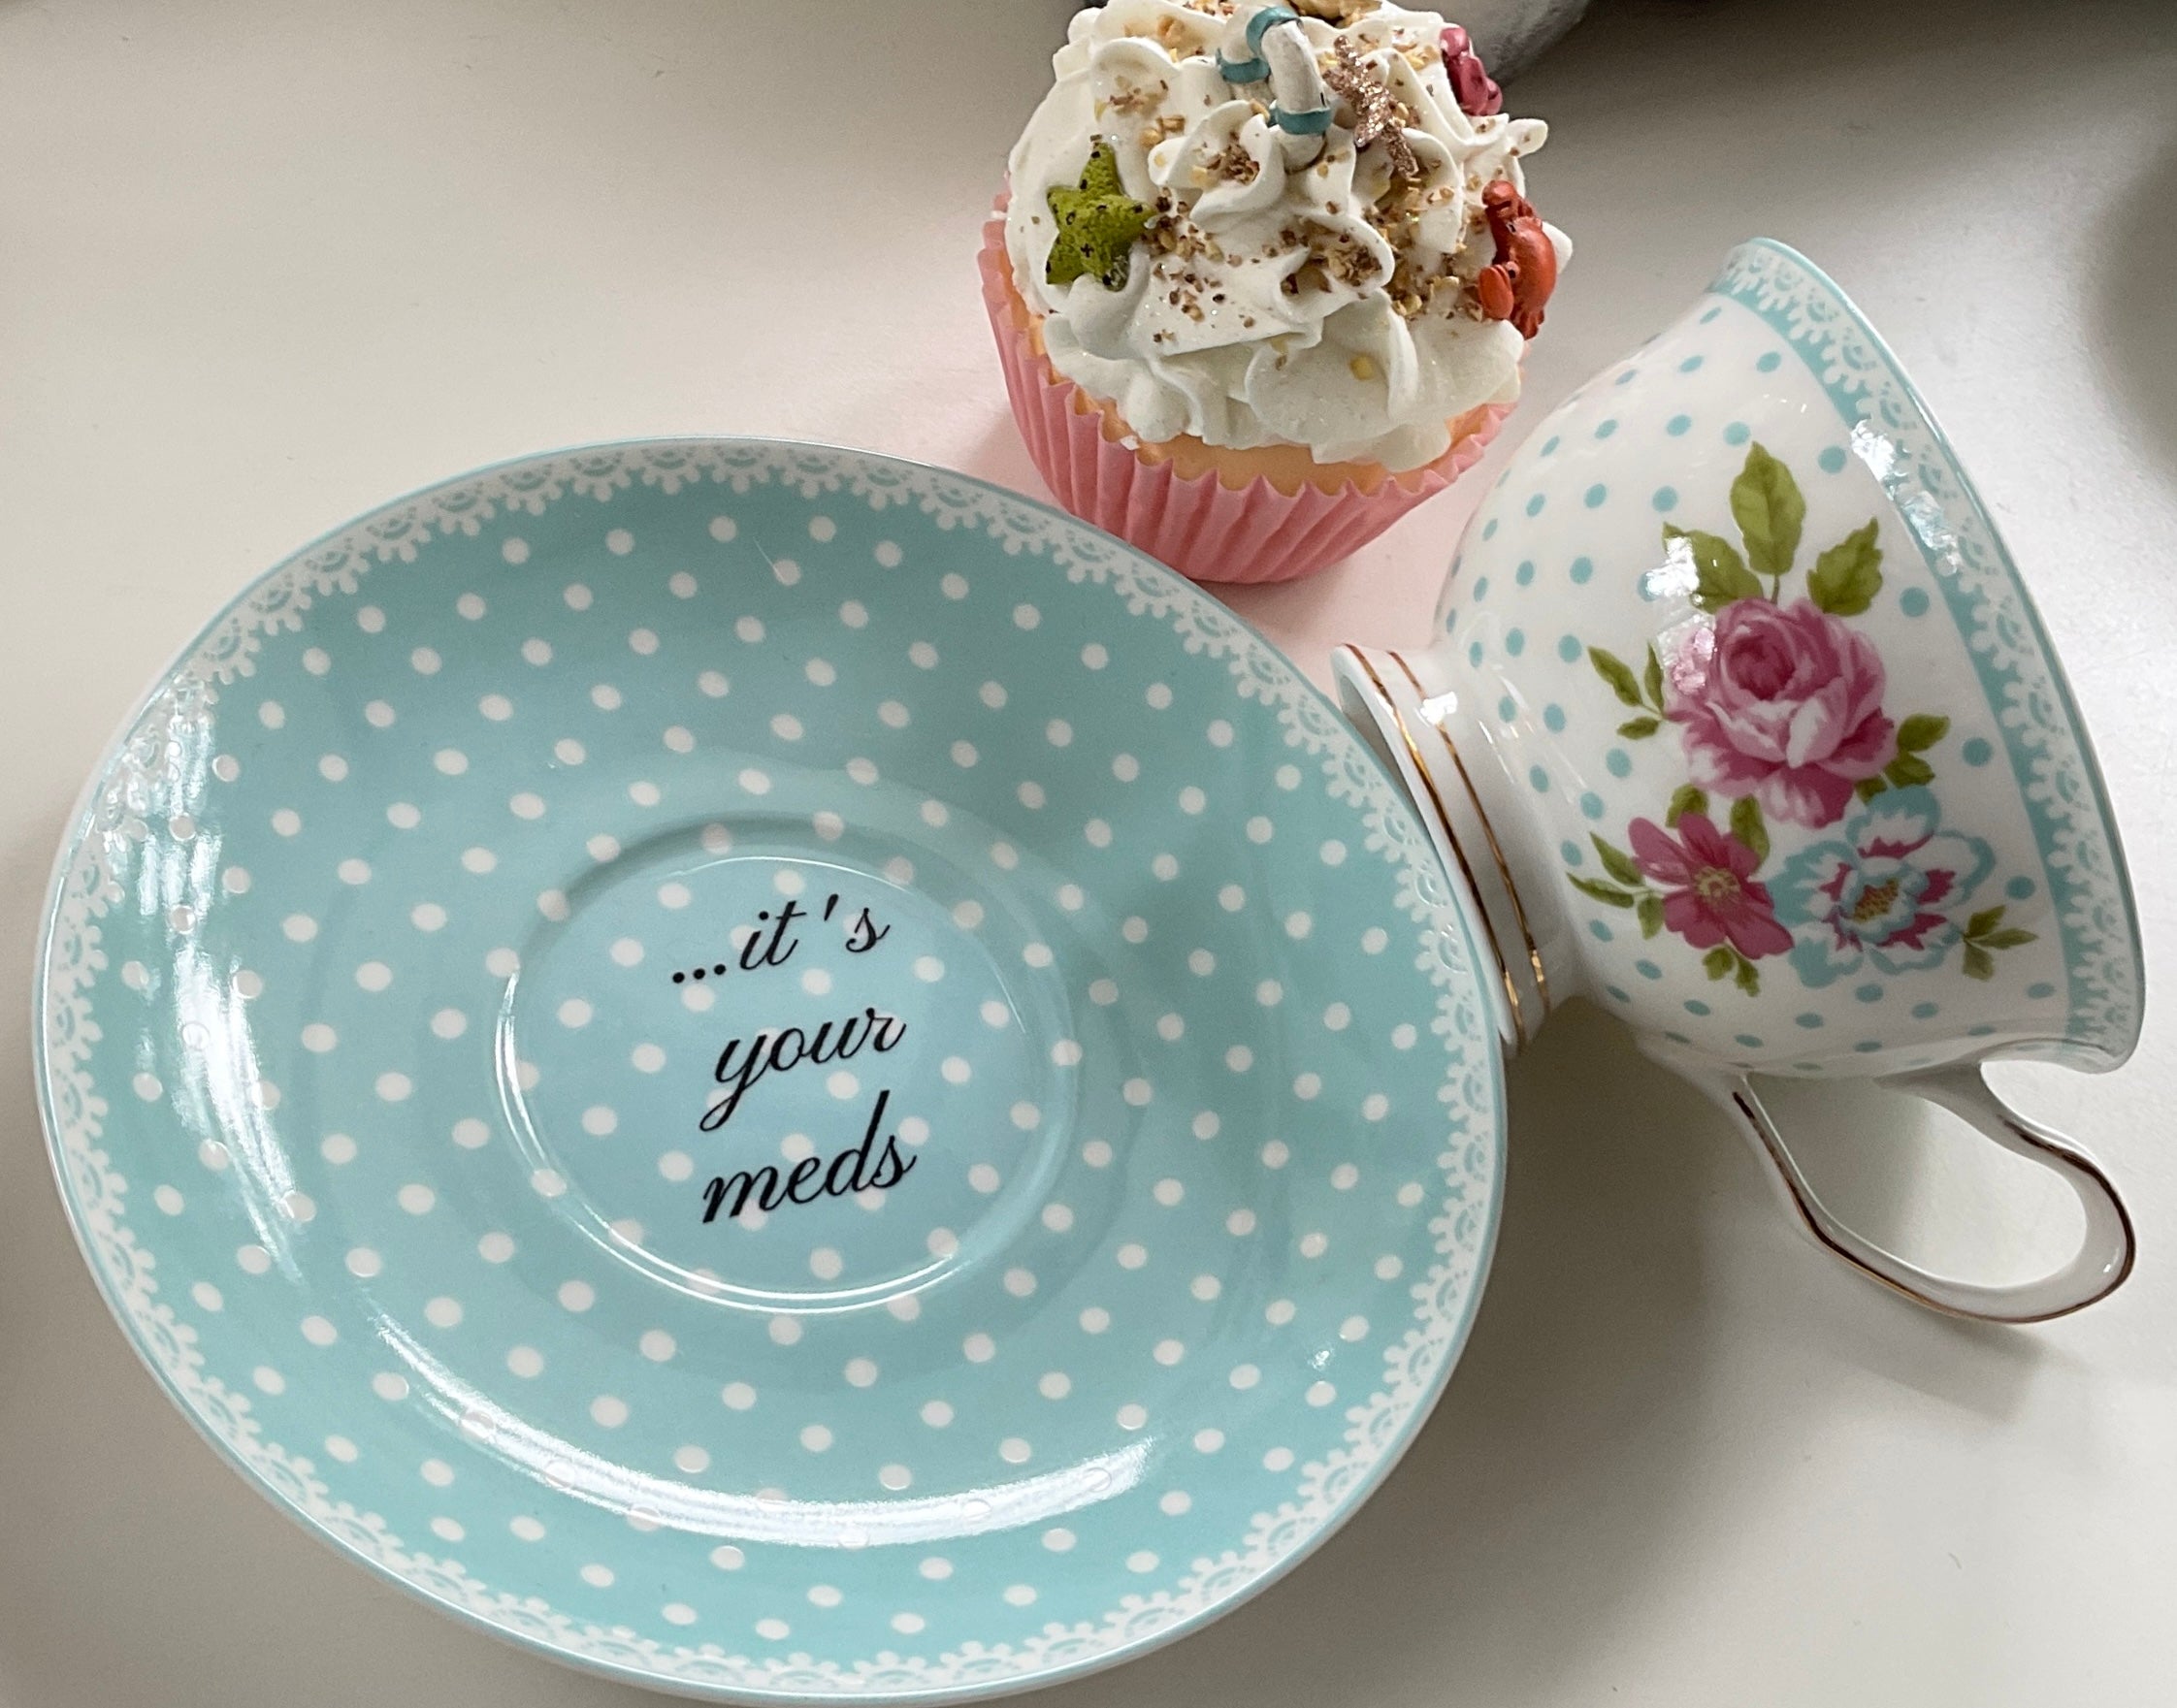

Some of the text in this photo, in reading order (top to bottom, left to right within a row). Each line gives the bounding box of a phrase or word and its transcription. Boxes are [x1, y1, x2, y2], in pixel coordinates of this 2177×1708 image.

[672, 893, 891, 983] ...it's
[699, 1007, 907, 1132] your
[702, 1089, 918, 1224] meds
